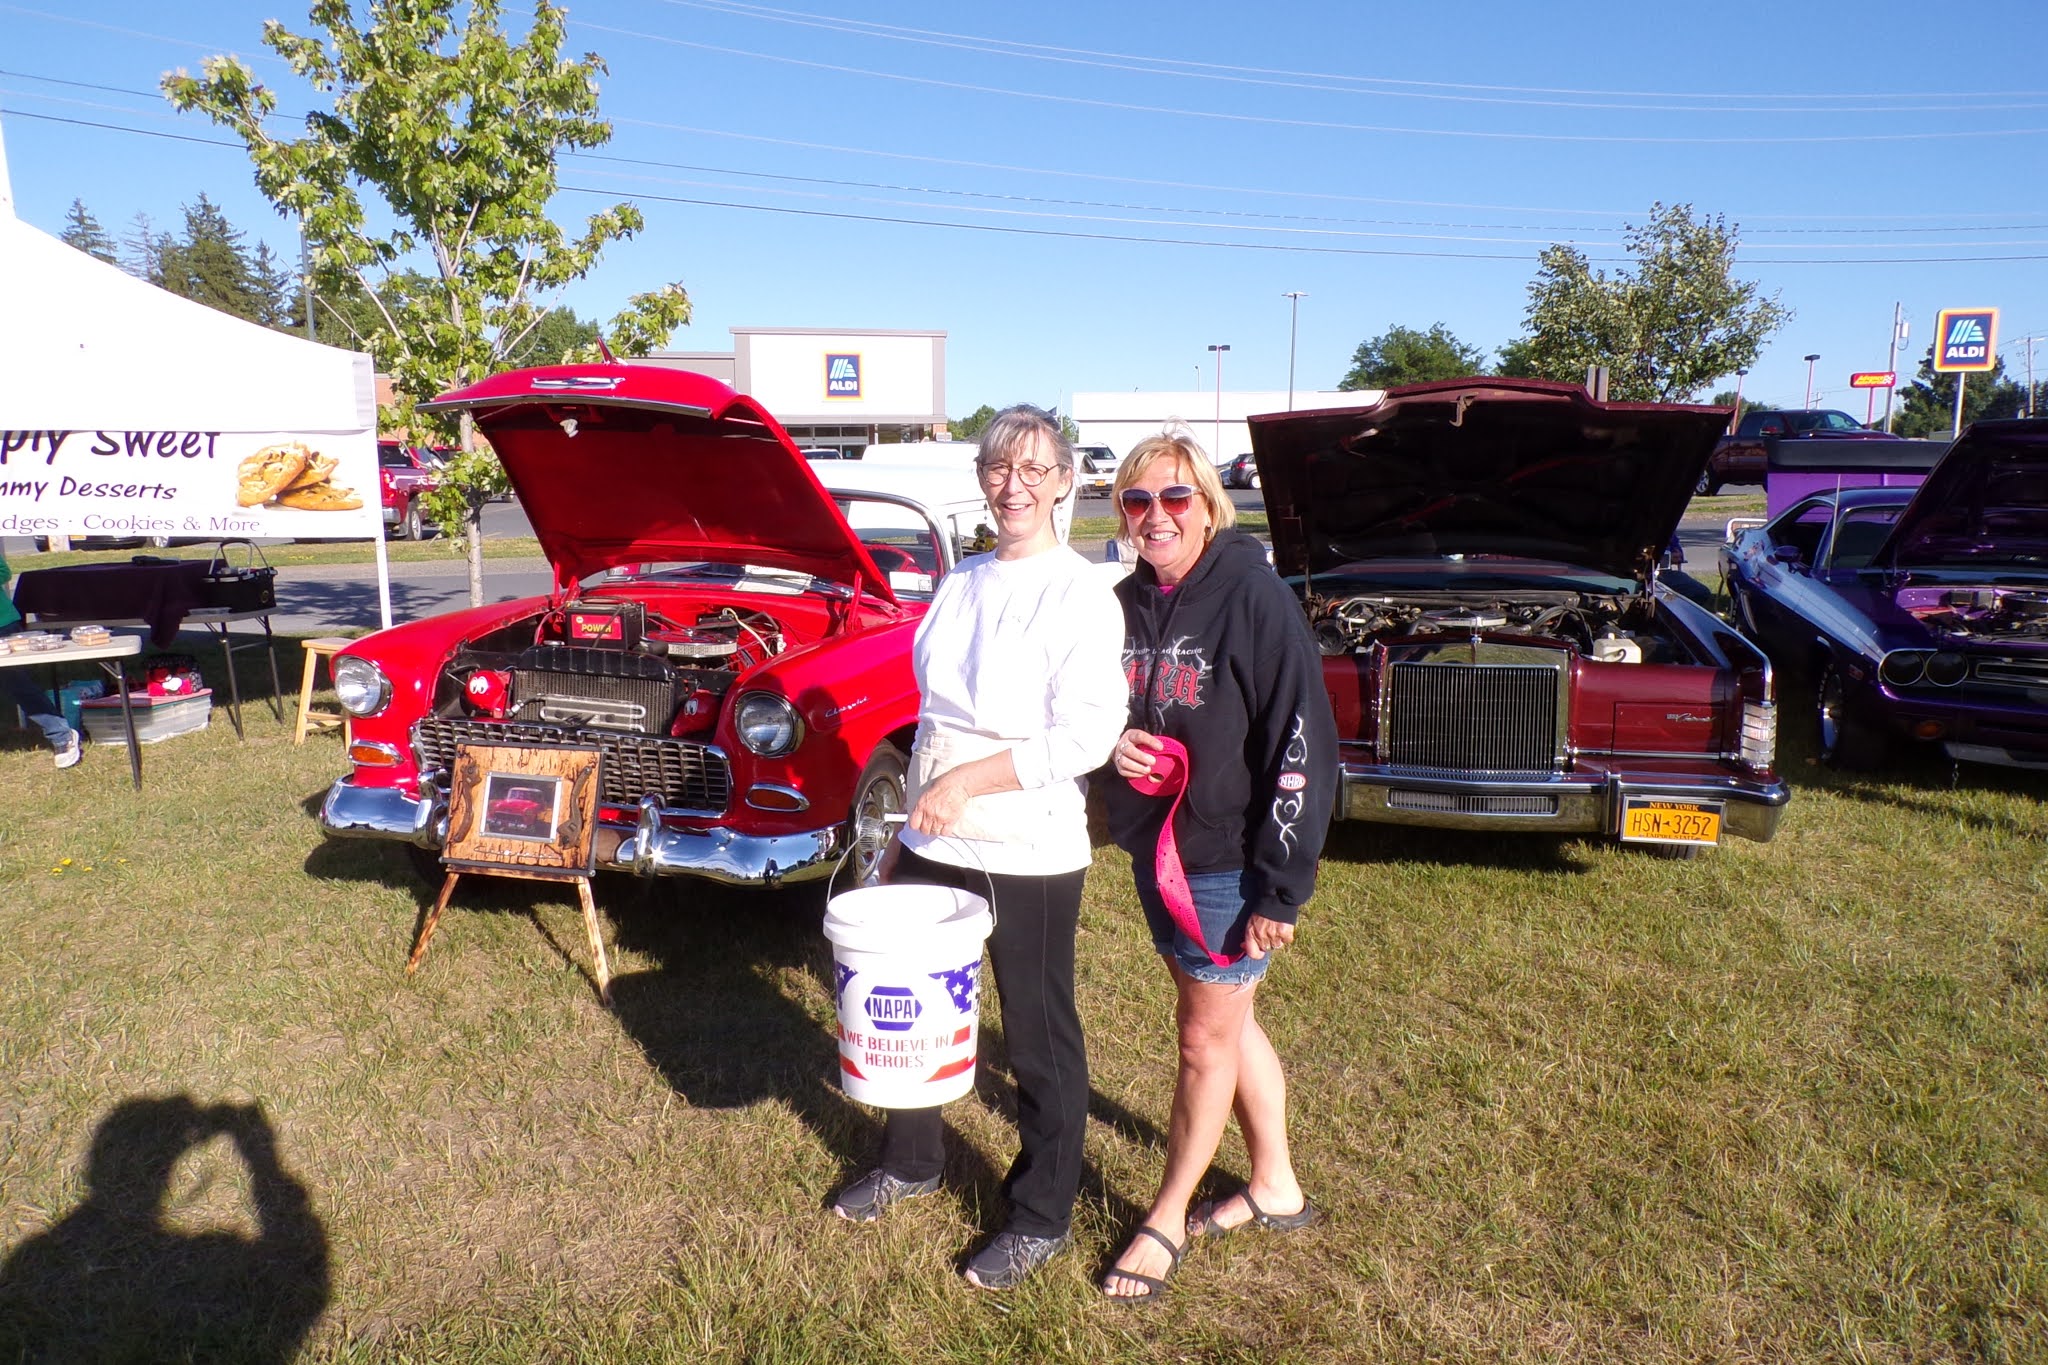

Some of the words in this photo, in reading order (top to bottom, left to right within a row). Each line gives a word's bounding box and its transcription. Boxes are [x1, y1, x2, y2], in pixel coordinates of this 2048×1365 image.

[1946, 346, 1985, 358] ALDI
[829, 380, 858, 391] ALDI
[91, 430, 221, 459] Sweet
[60, 476, 177, 500] Desserts
[83, 514, 175, 531] Cookies
[183, 516, 200, 531] &
[209, 517, 260, 532] More
[581, 624, 612, 633] POWR
[1649, 801, 1673, 809] NEW
[1675, 803, 1701, 811] YORK
[1632, 812, 1662, 833] HSN
[1672, 814, 1712, 836] 3252
[873, 997, 912, 1019] NAPA
[846, 1029, 863, 1047] WE
[868, 1036, 928, 1052] BELIEVE
[935, 1034, 949, 1049] IN
[865, 1052, 924, 1068] HEROES
